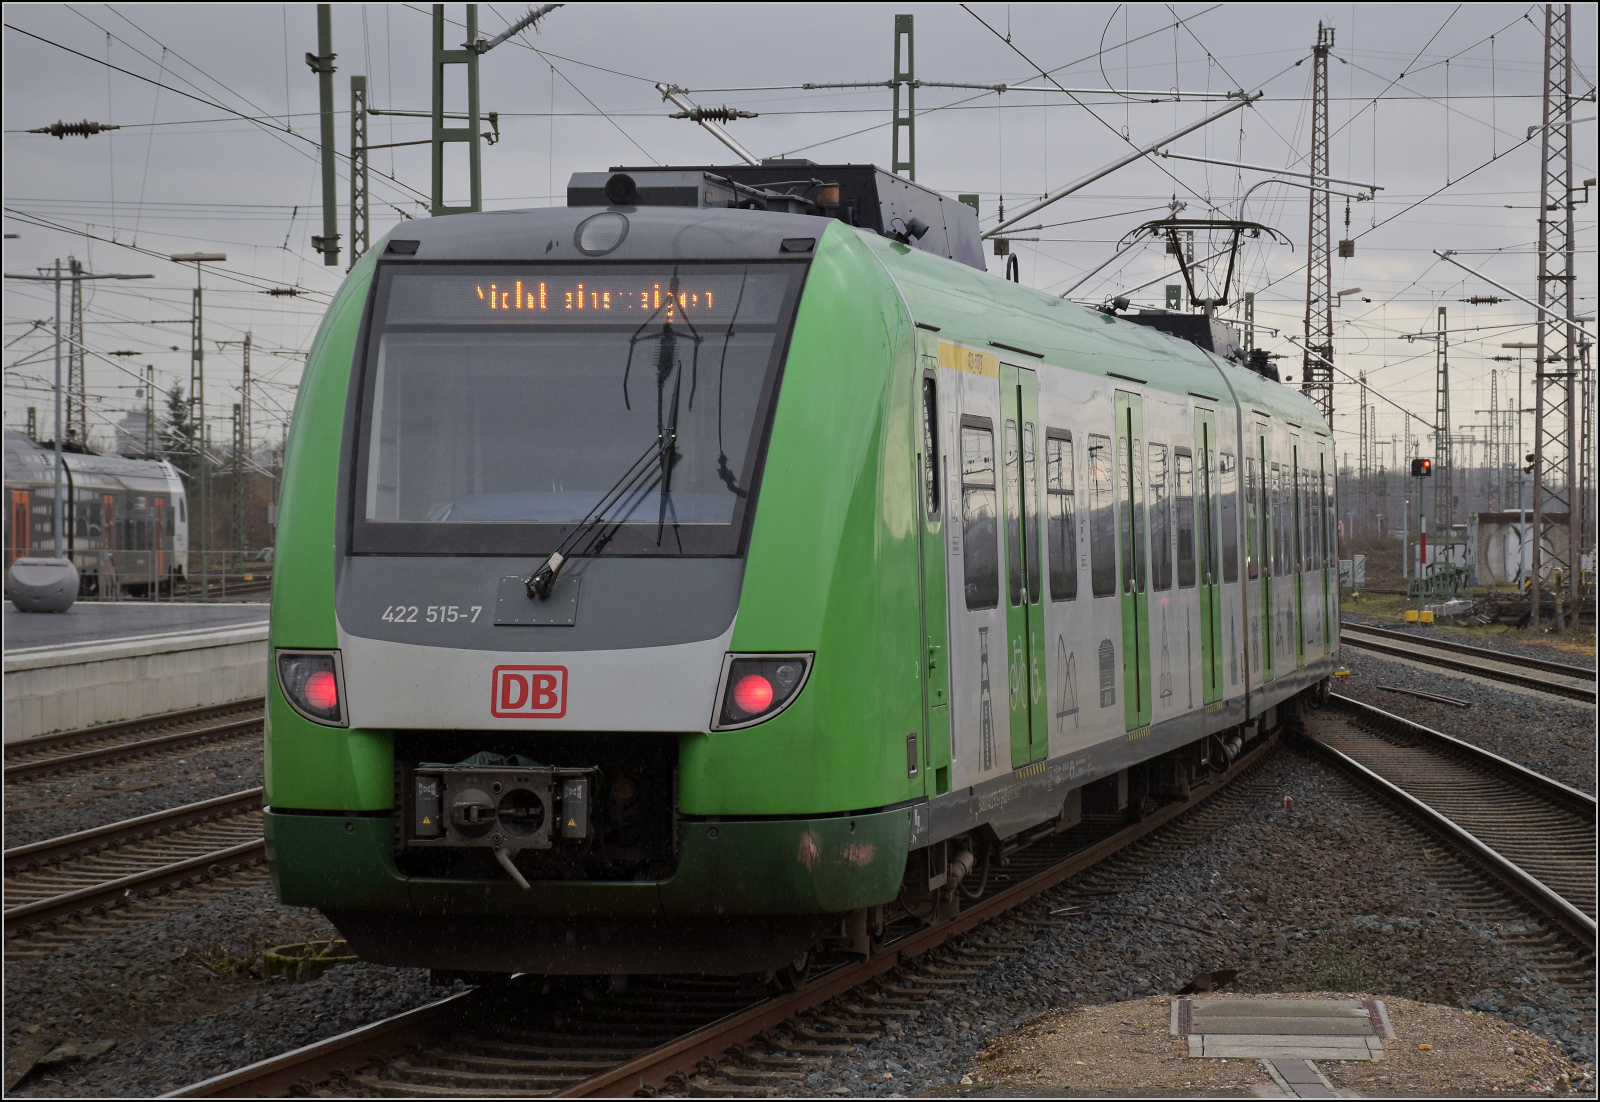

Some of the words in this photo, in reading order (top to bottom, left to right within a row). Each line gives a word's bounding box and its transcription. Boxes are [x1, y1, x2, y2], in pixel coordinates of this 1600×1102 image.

[381, 605, 418, 624] 422
[426, 605, 483, 624] 515-7
[499, 672, 560, 711] DB
